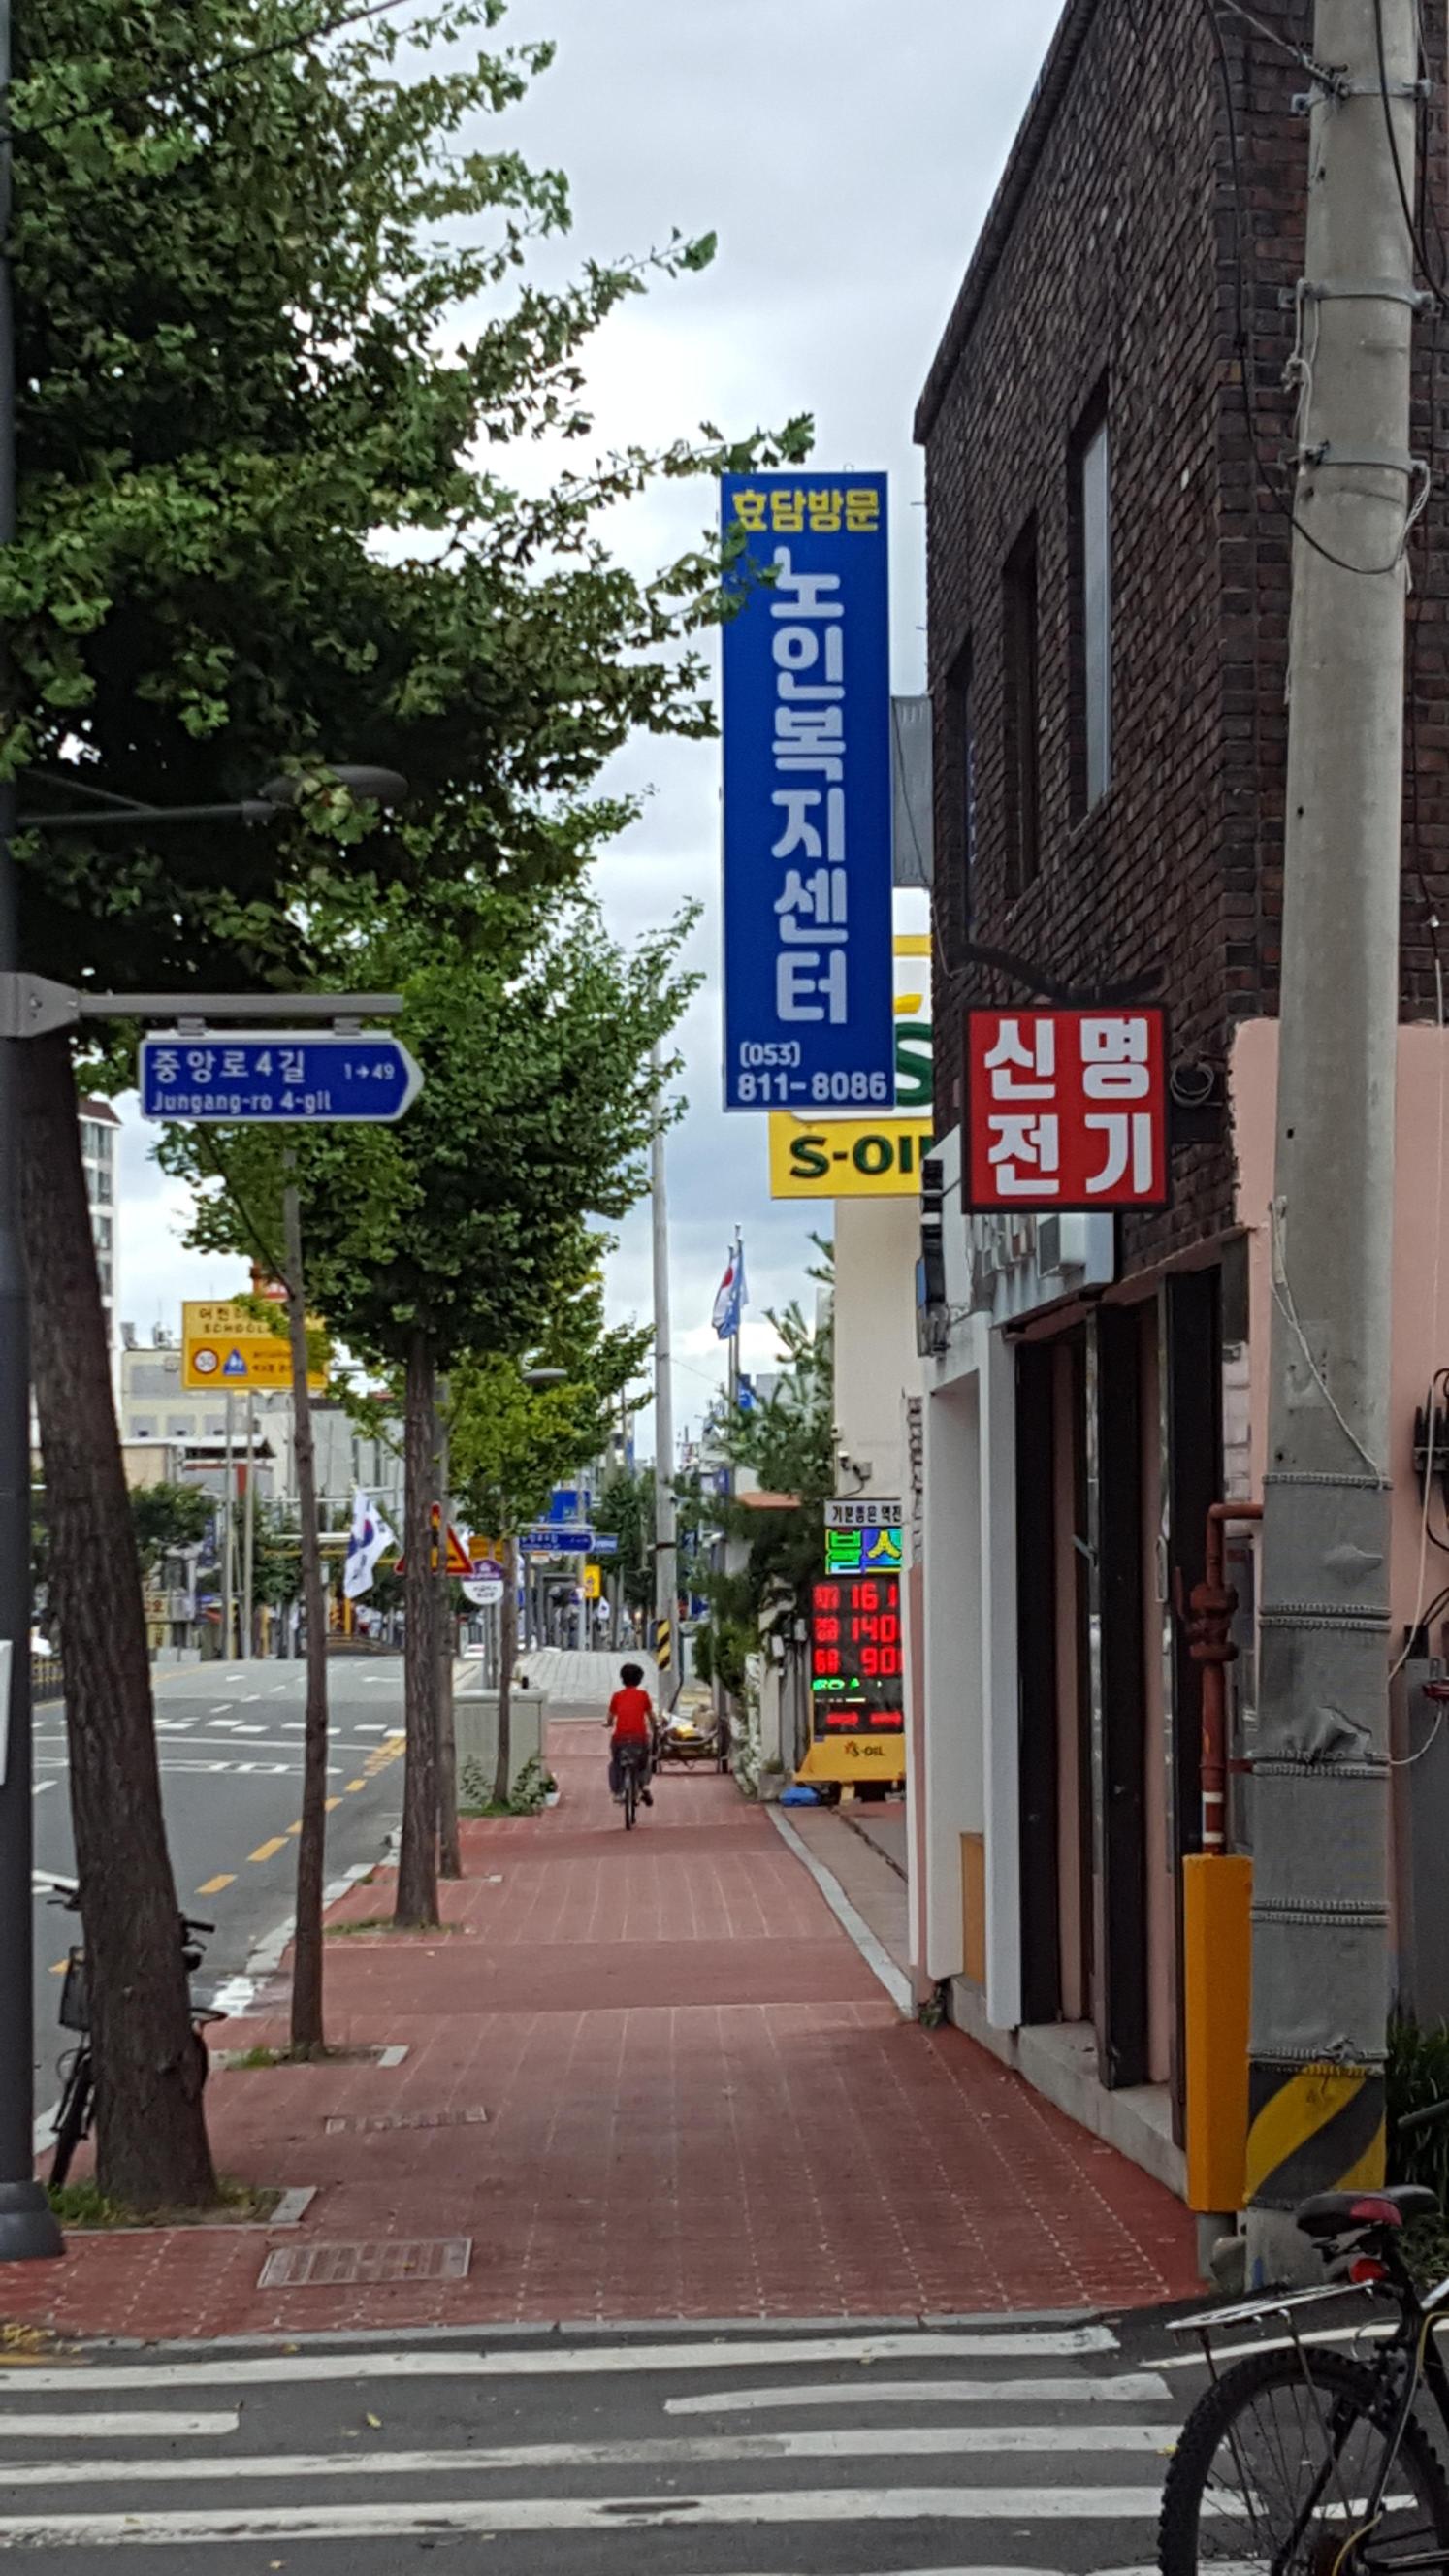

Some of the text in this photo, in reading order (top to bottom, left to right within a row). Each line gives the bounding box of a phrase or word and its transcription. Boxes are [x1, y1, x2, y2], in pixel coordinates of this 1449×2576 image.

[732, 489, 880, 532] 효담방문
[770, 545, 849, 1024] 노인복지센터
[152, 1049, 306, 1084] 중앙로4길
[739, 1040, 801, 1067] (053)
[983, 1017, 1150, 1101] 신명
[152, 1090, 332, 1114] Jungang-ro 4-gil
[737, 1071, 887, 1102] 811-8086
[987, 1112, 1154, 1196] 전기
